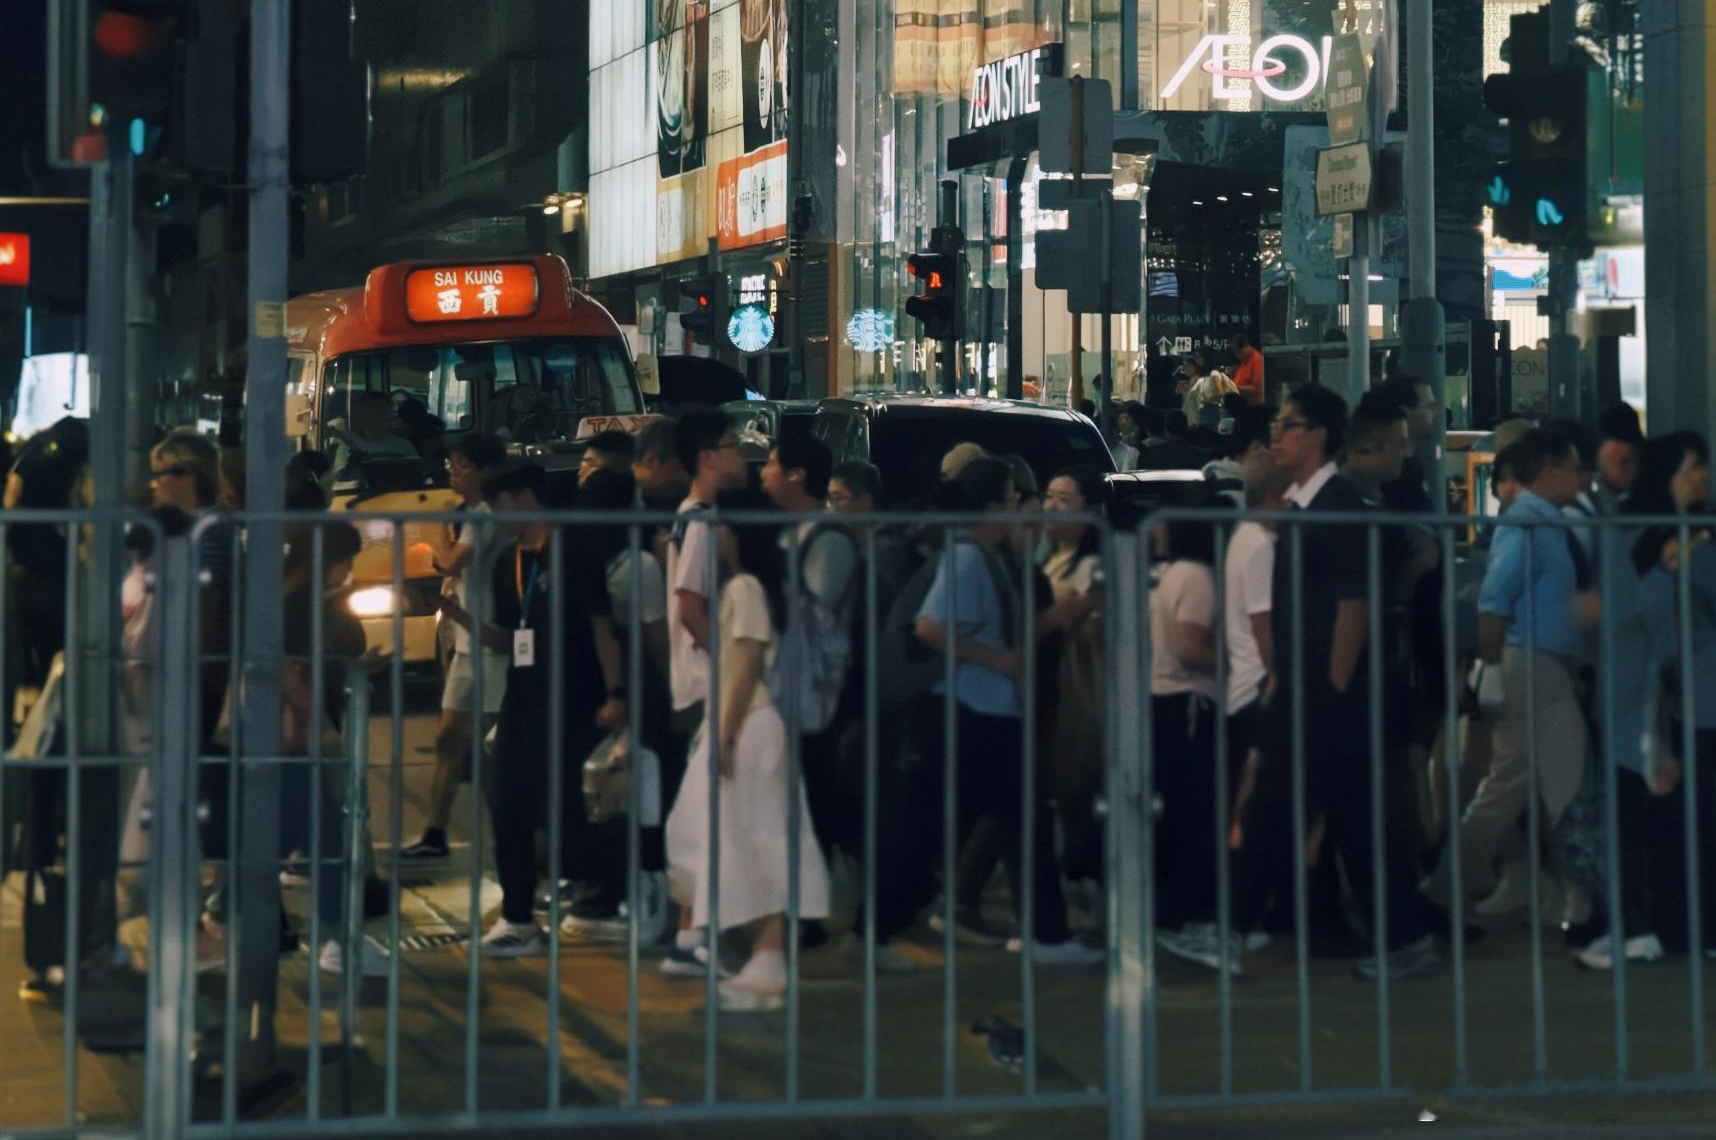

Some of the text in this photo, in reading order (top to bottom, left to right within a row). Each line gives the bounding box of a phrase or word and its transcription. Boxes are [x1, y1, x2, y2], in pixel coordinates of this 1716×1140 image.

[1002, 48, 1041, 121] STYLE
[434, 269, 503, 287] SAI KUNG
[437, 285, 503, 315] 西貢
